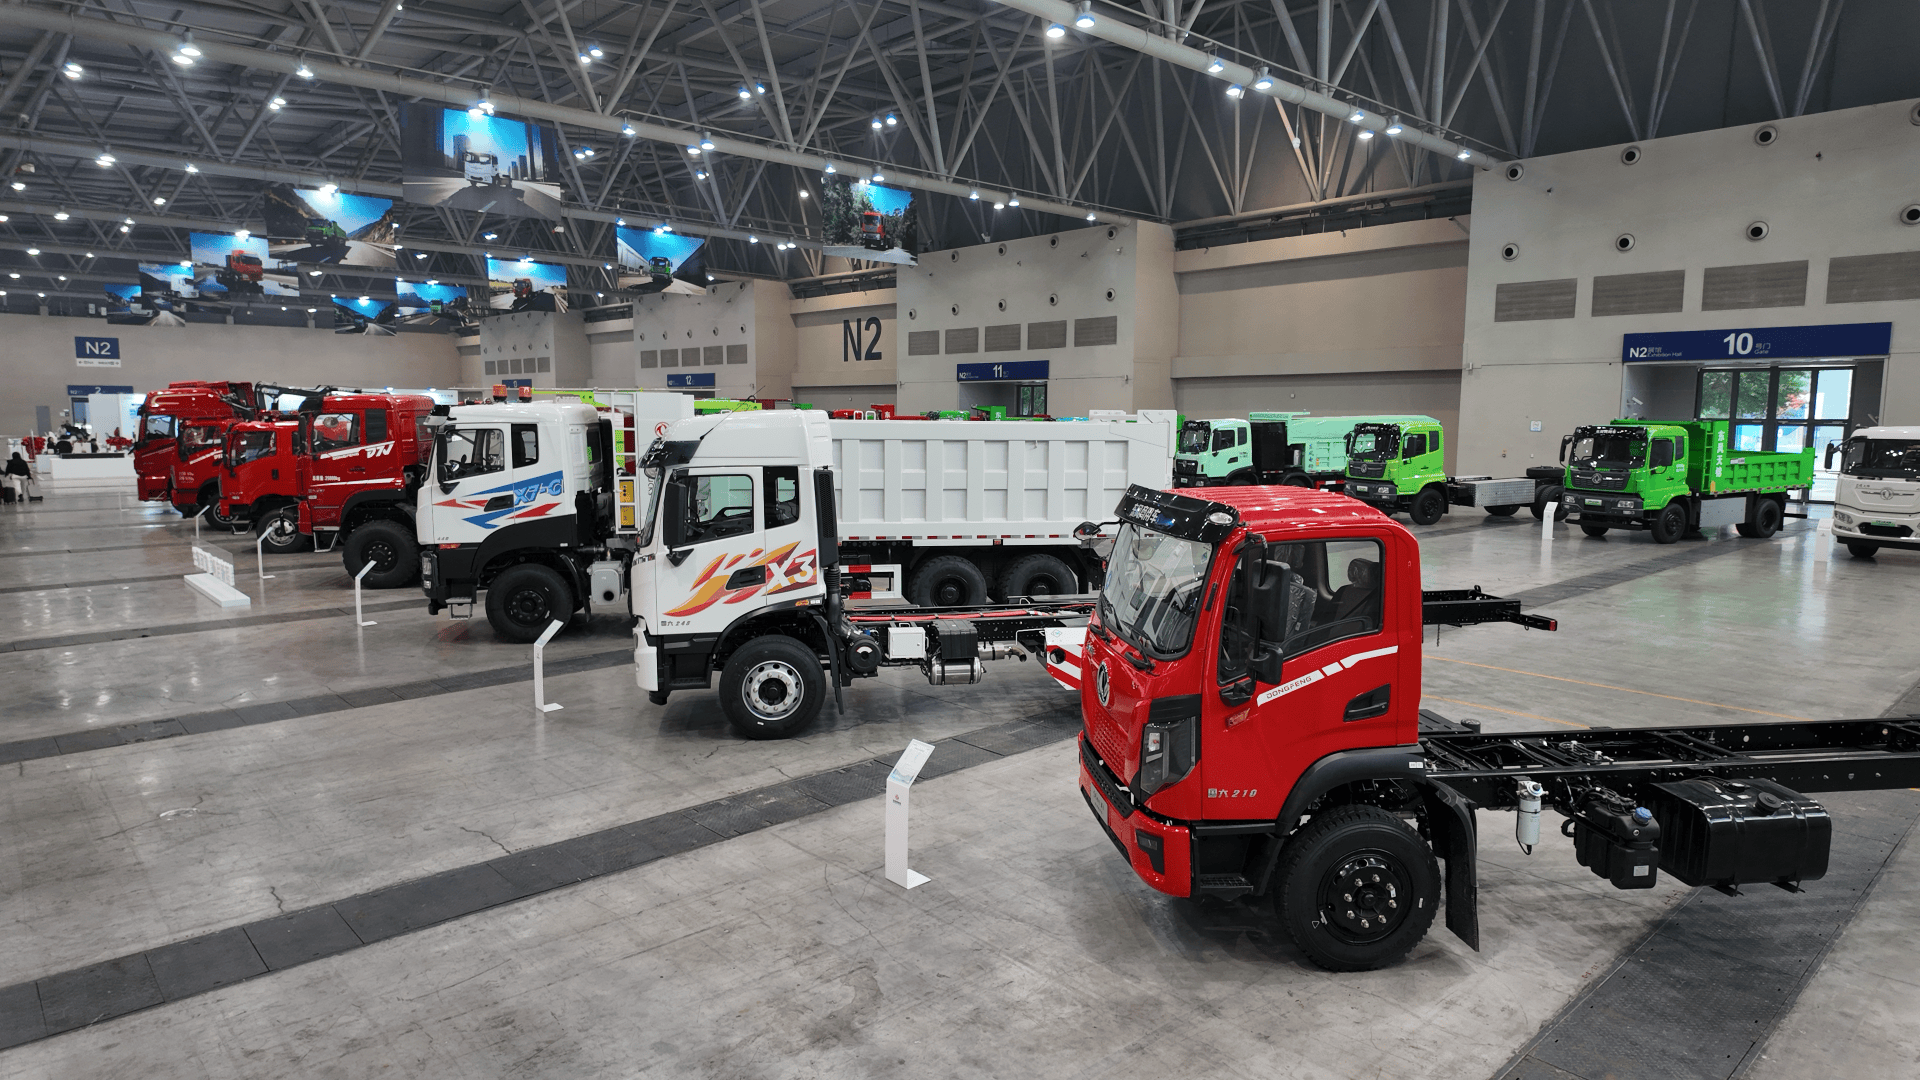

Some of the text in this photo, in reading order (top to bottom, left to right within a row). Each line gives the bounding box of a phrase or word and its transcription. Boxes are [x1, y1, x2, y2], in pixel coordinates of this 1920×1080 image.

[843, 316, 882, 362] N2
[1723, 332, 1754, 355] 10
[86, 341, 111, 355] N2
[1629, 347, 1648, 358] N2
[993, 364, 1003, 378] 11
[685, 375, 692, 385] 12
[95, 386, 102, 394] 2
[765, 552, 815, 590] X3
[1266, 675, 1312, 699] DONGFENG
[1207, 788, 1258, 799] 国六 210
